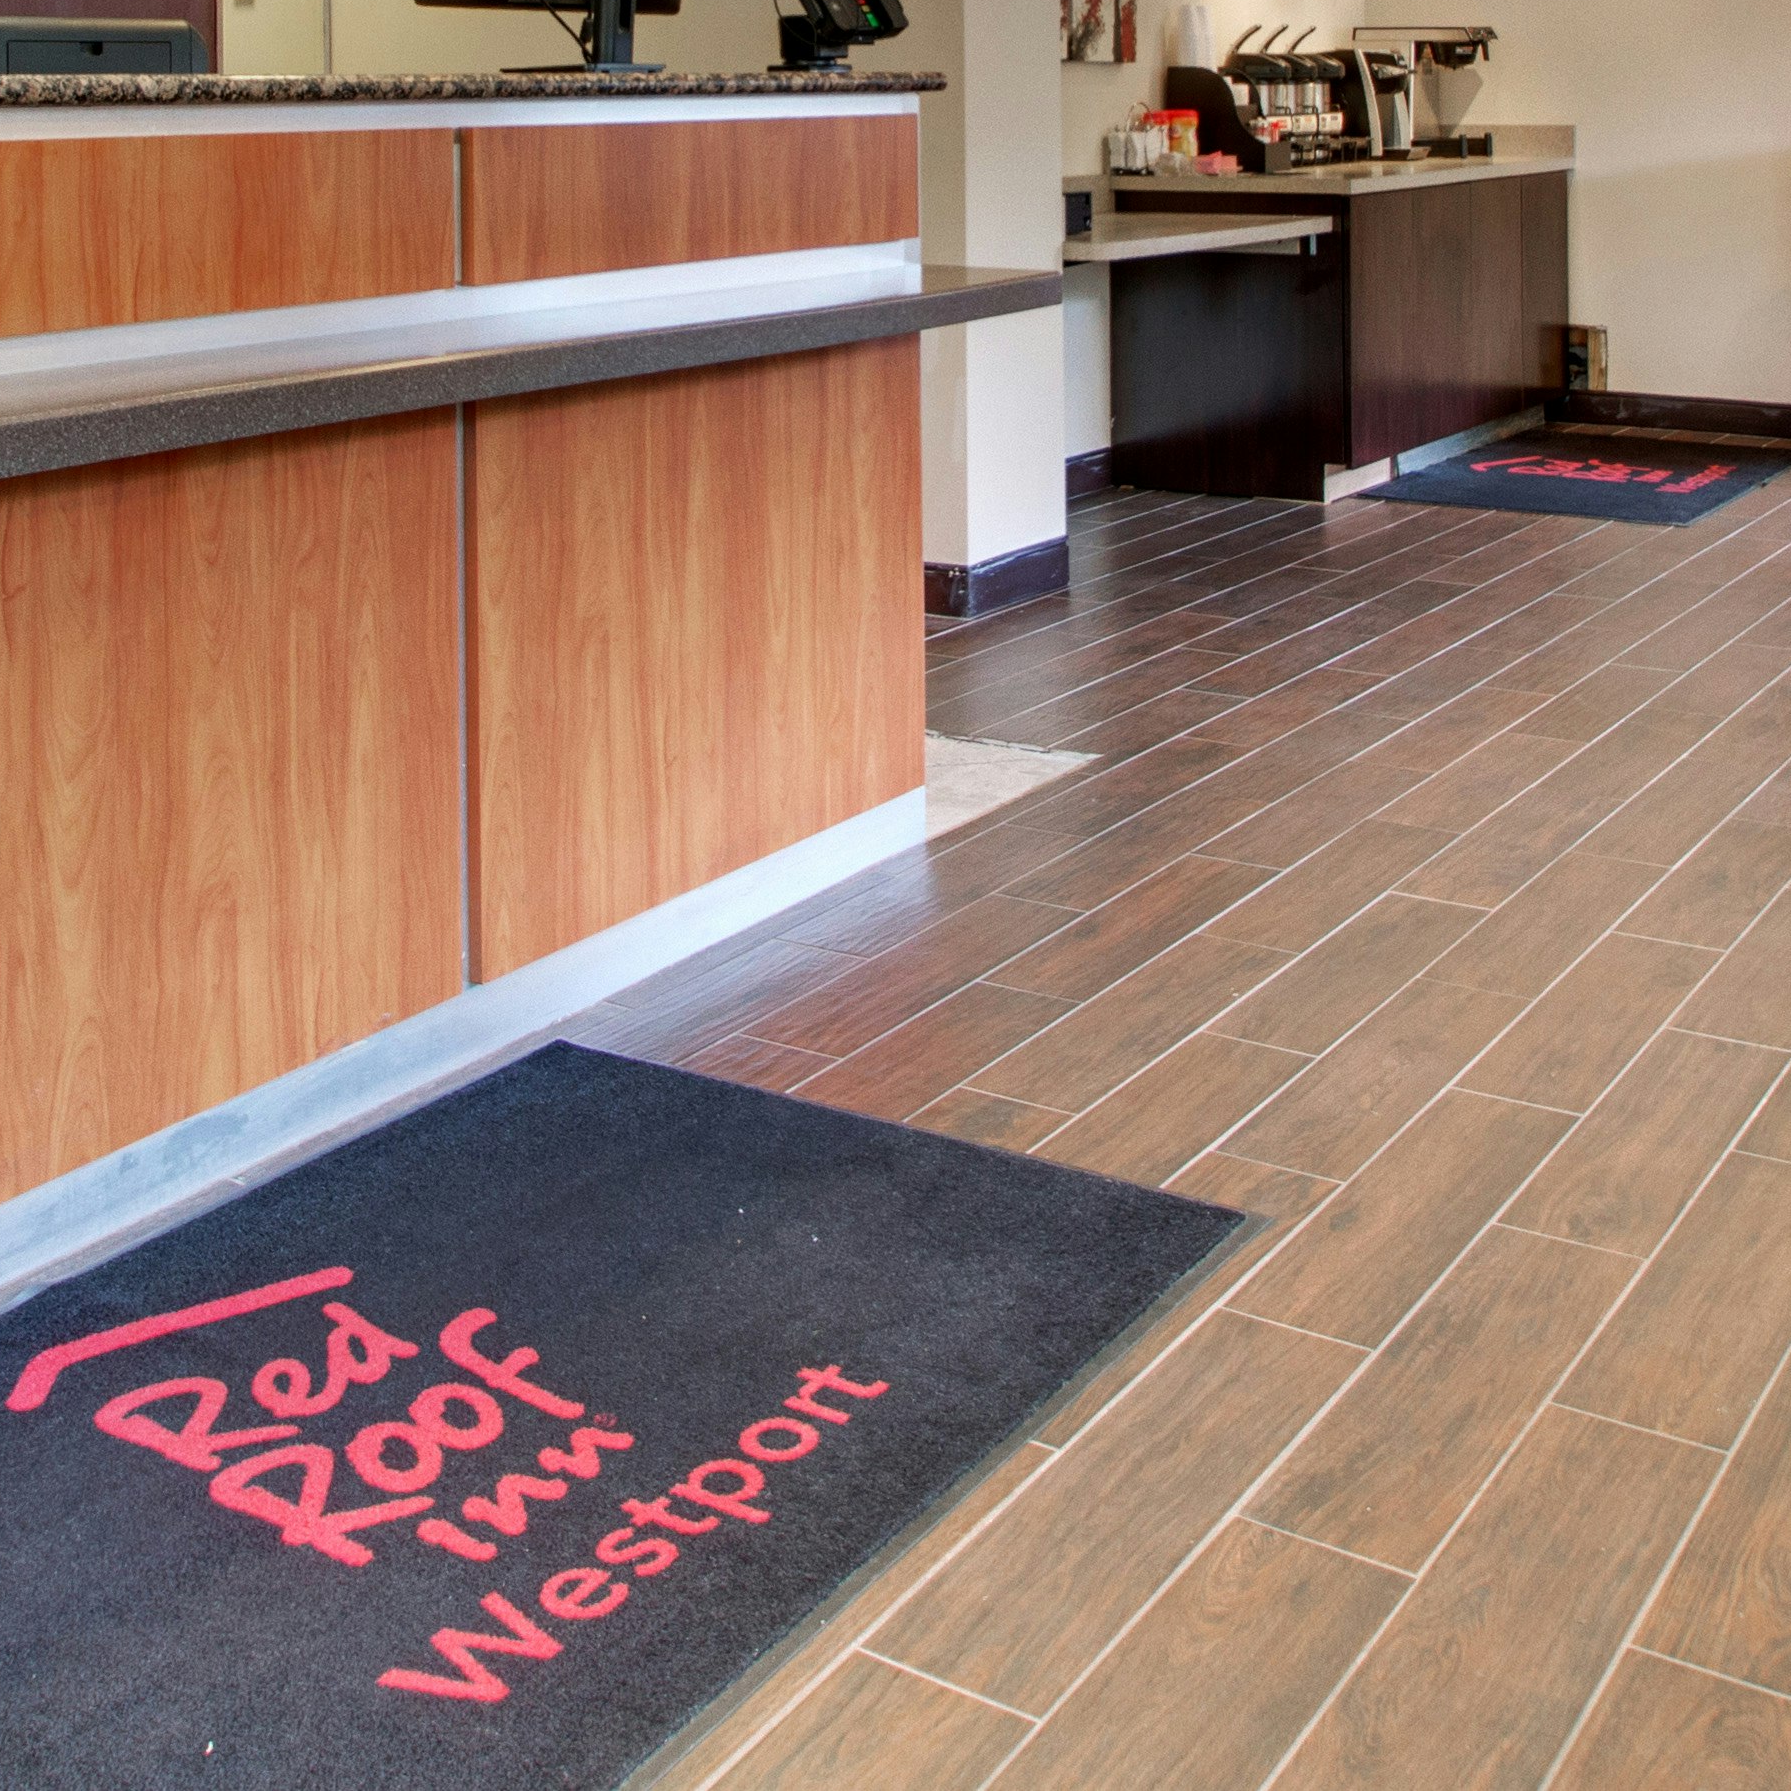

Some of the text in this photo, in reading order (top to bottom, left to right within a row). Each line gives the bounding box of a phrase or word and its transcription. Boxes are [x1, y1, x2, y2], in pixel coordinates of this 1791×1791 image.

[93, 1302, 420, 1472] Red
[209, 1308, 586, 1567] Roof
[377, 1366, 890, 1704] Westport
